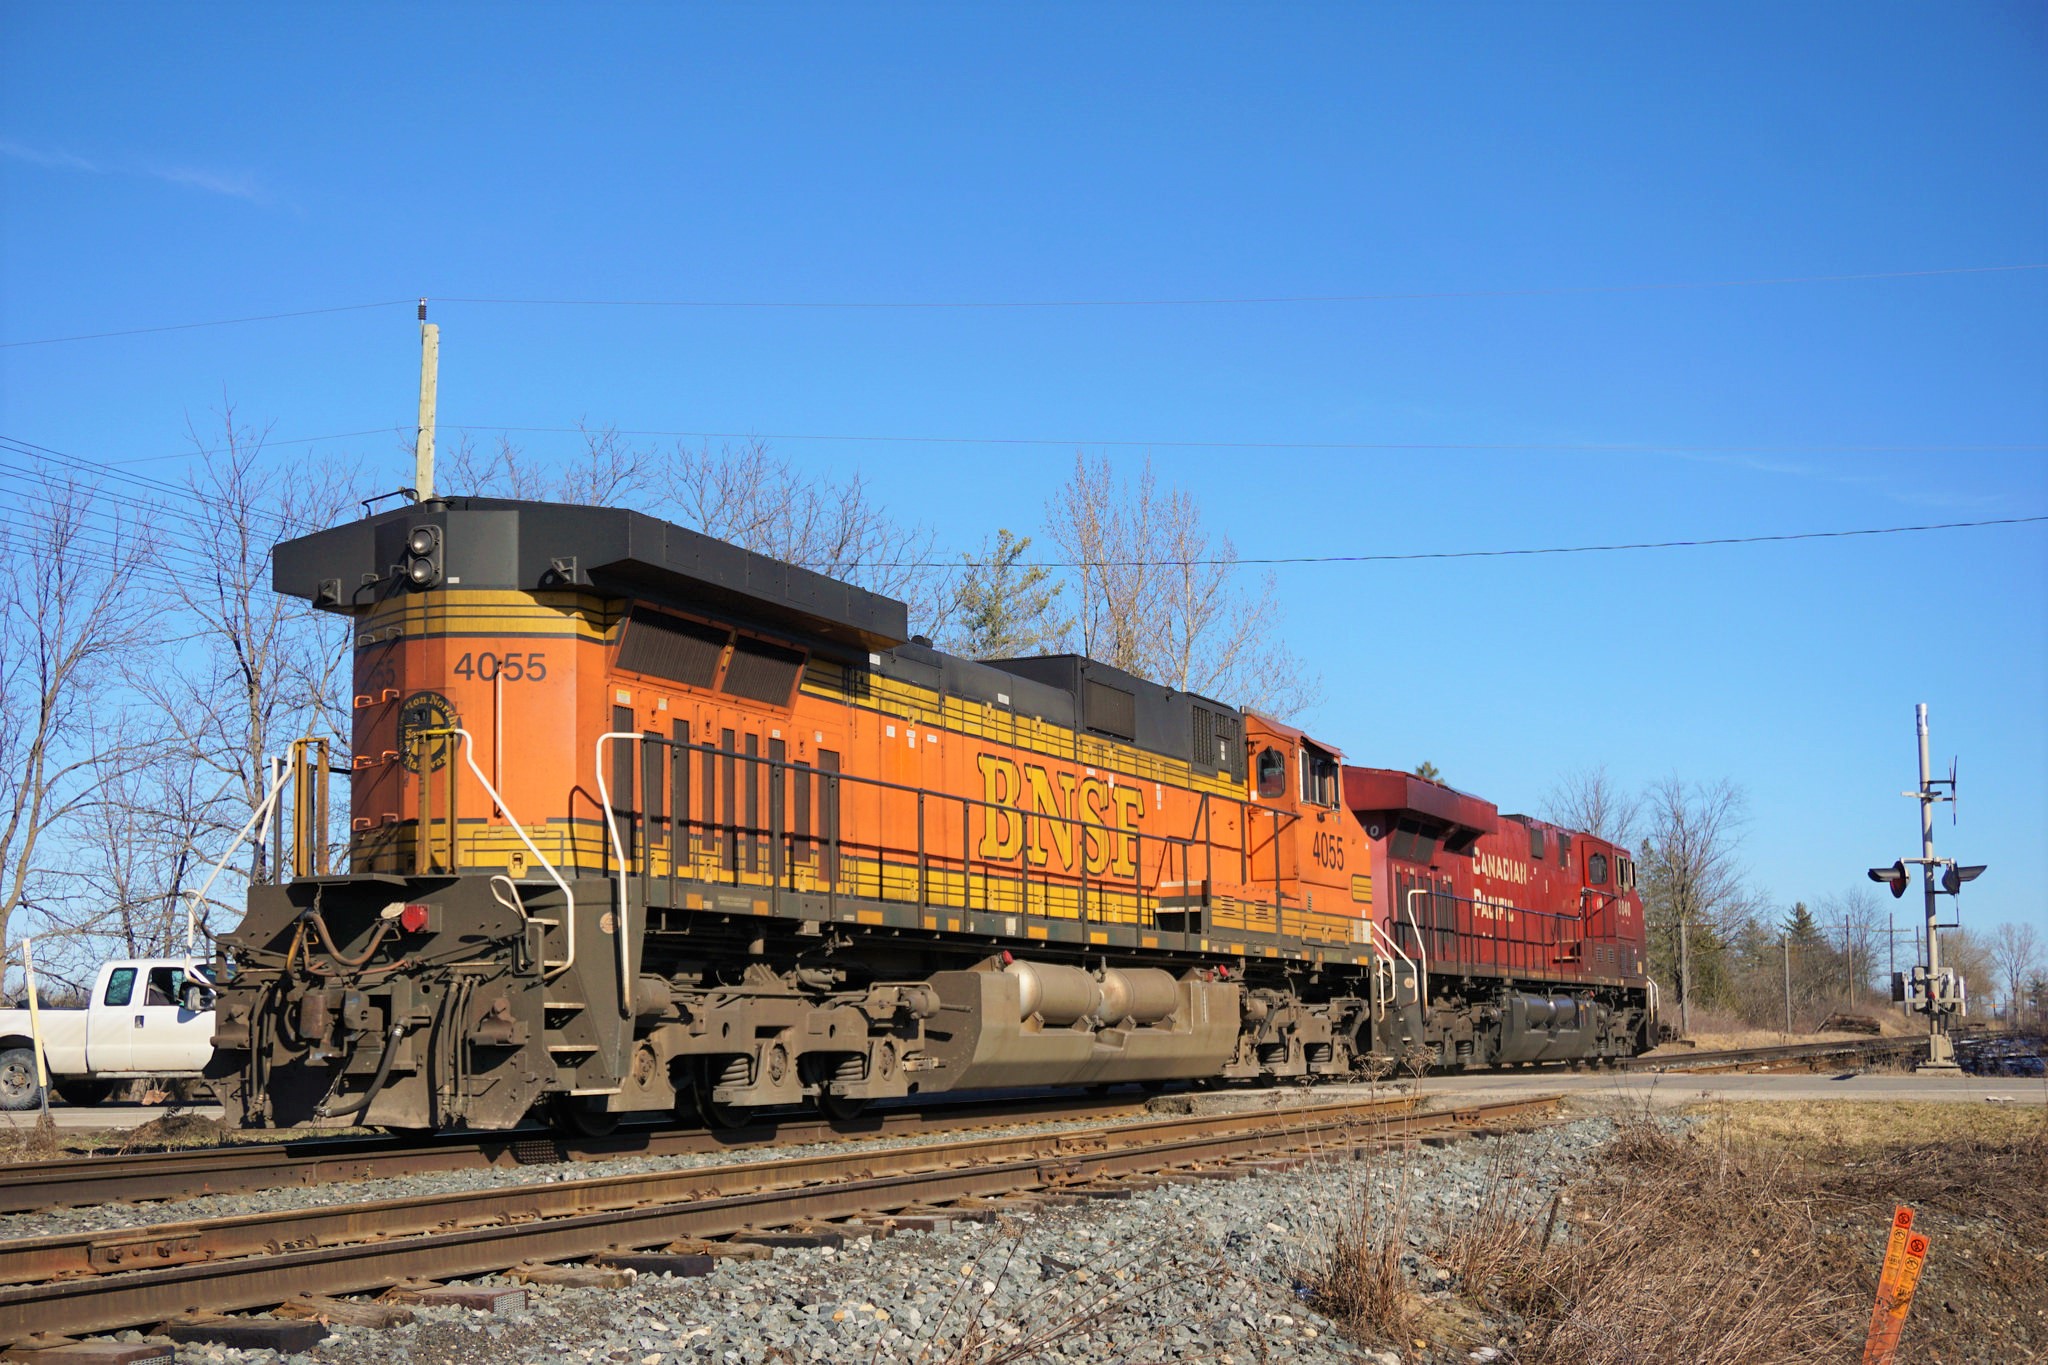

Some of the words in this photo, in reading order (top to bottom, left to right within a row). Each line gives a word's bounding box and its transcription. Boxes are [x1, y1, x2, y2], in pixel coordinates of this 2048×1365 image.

[453, 652, 547, 682] 4055
[977, 752, 1145, 879] BNSF
[1313, 831, 1344, 871] 4055
[1472, 846, 1527, 885] CANADIAN
[1473, 888, 1514, 922] PACIFIC
